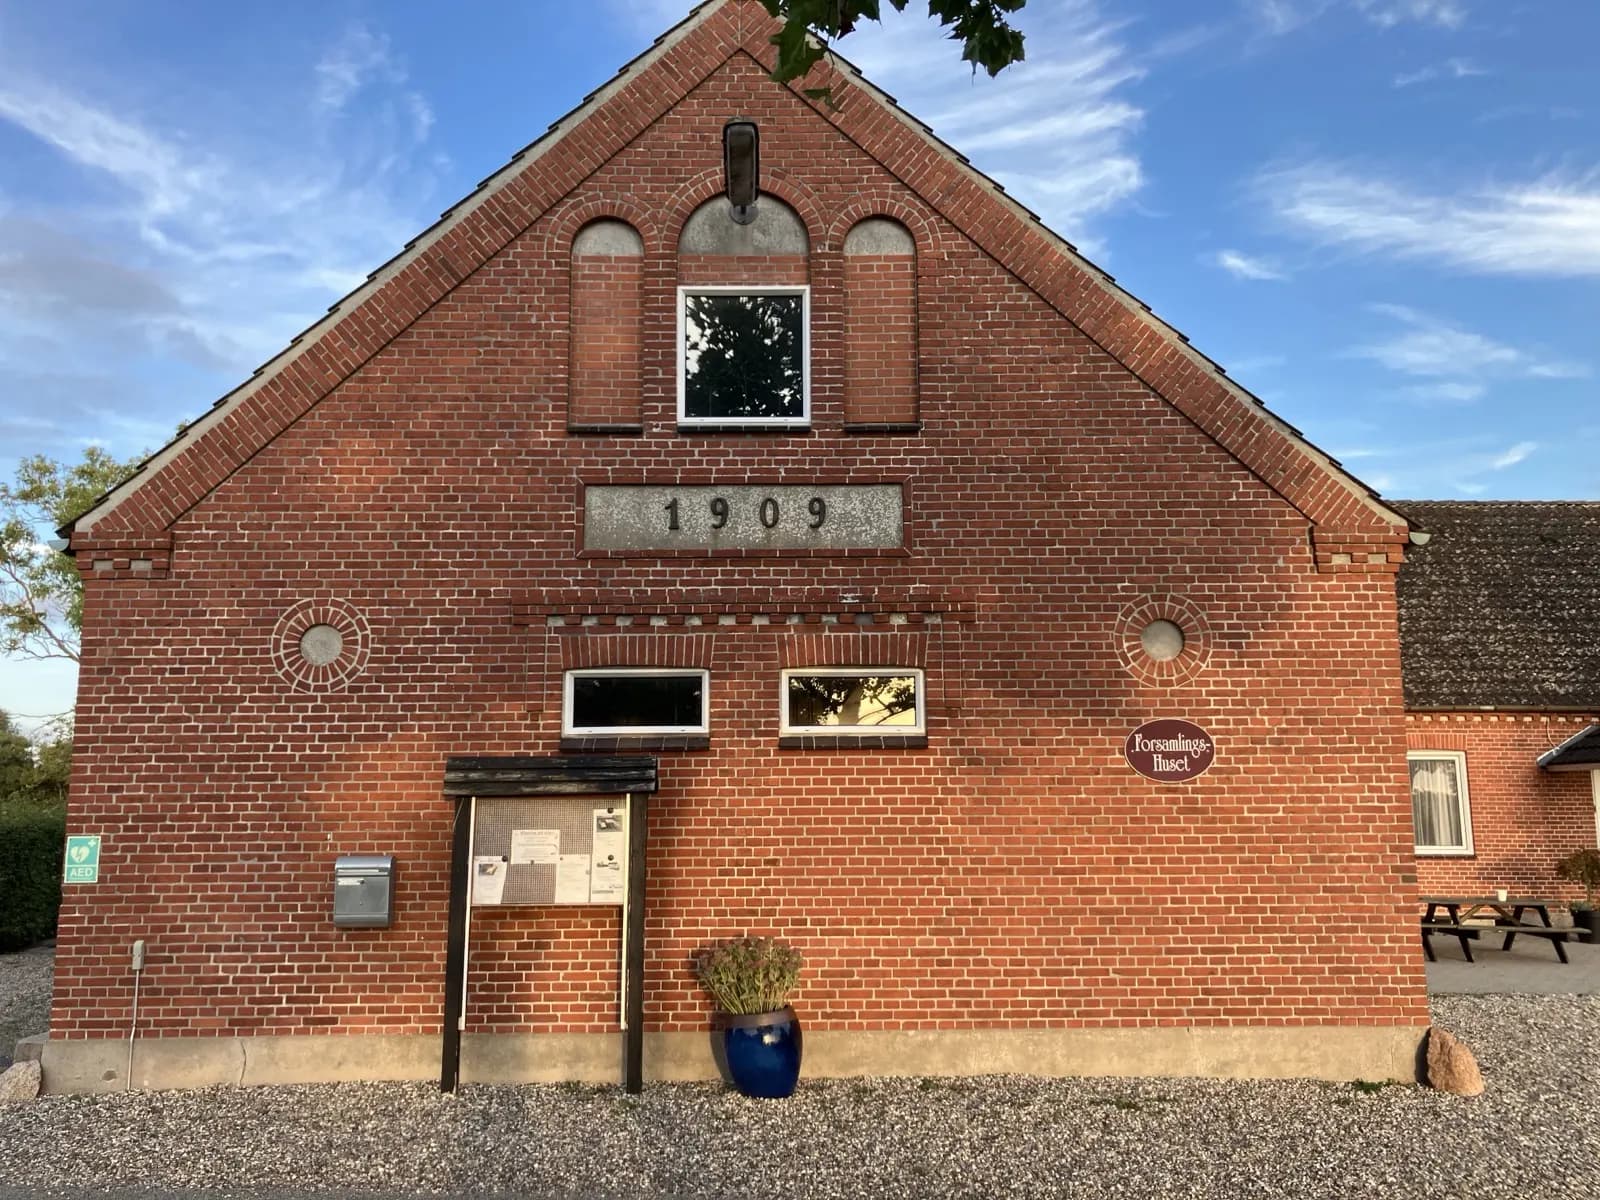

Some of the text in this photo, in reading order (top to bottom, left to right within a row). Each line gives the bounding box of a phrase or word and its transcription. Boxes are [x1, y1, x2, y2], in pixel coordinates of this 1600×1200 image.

[664, 497, 826, 530] 1909
[1134, 732, 1211, 758] Forsamlings-
[1152, 754, 1191, 772] Huset
[70, 867, 94, 877] AED
